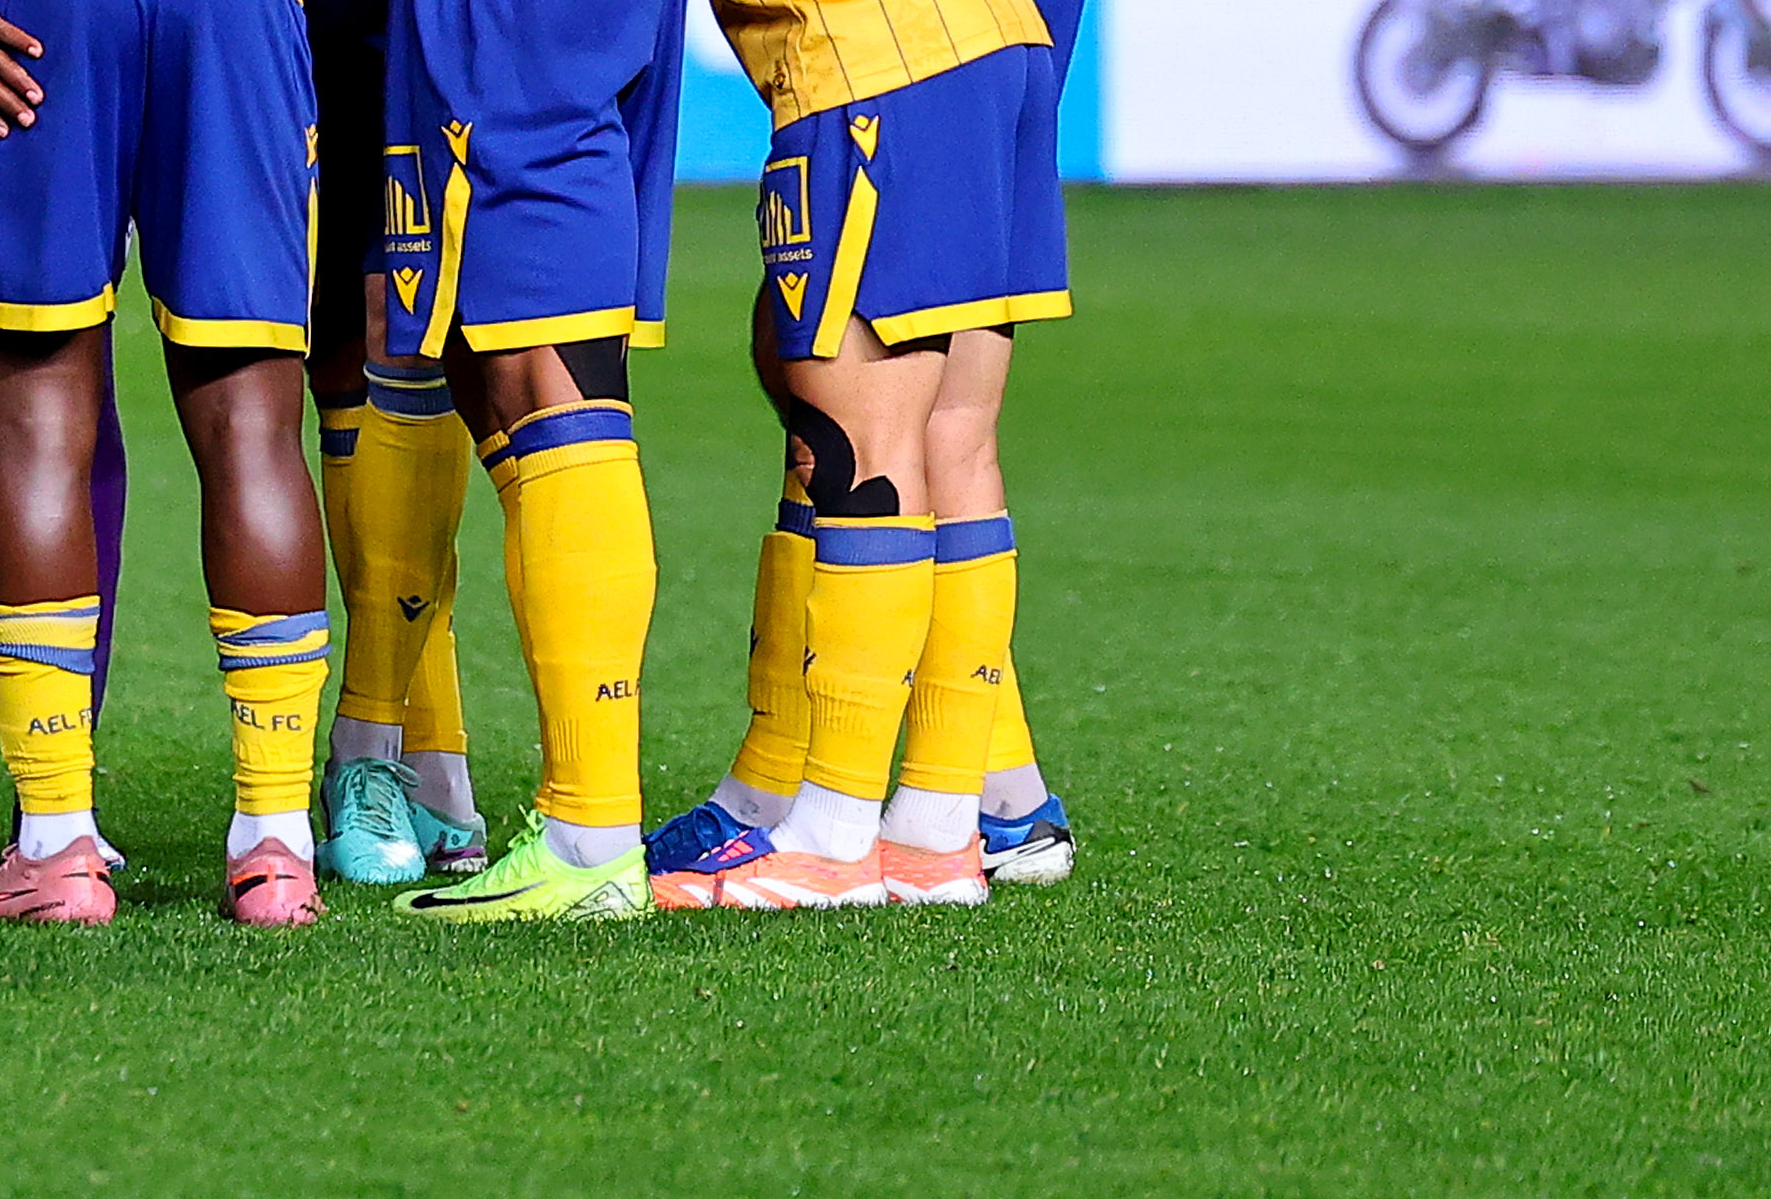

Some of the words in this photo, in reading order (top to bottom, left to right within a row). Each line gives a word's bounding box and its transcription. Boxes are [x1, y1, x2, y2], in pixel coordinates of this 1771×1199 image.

[595, 678, 632, 703] AEL
[28, 713, 77, 736] AEL
[271, 713, 302, 732] FC
